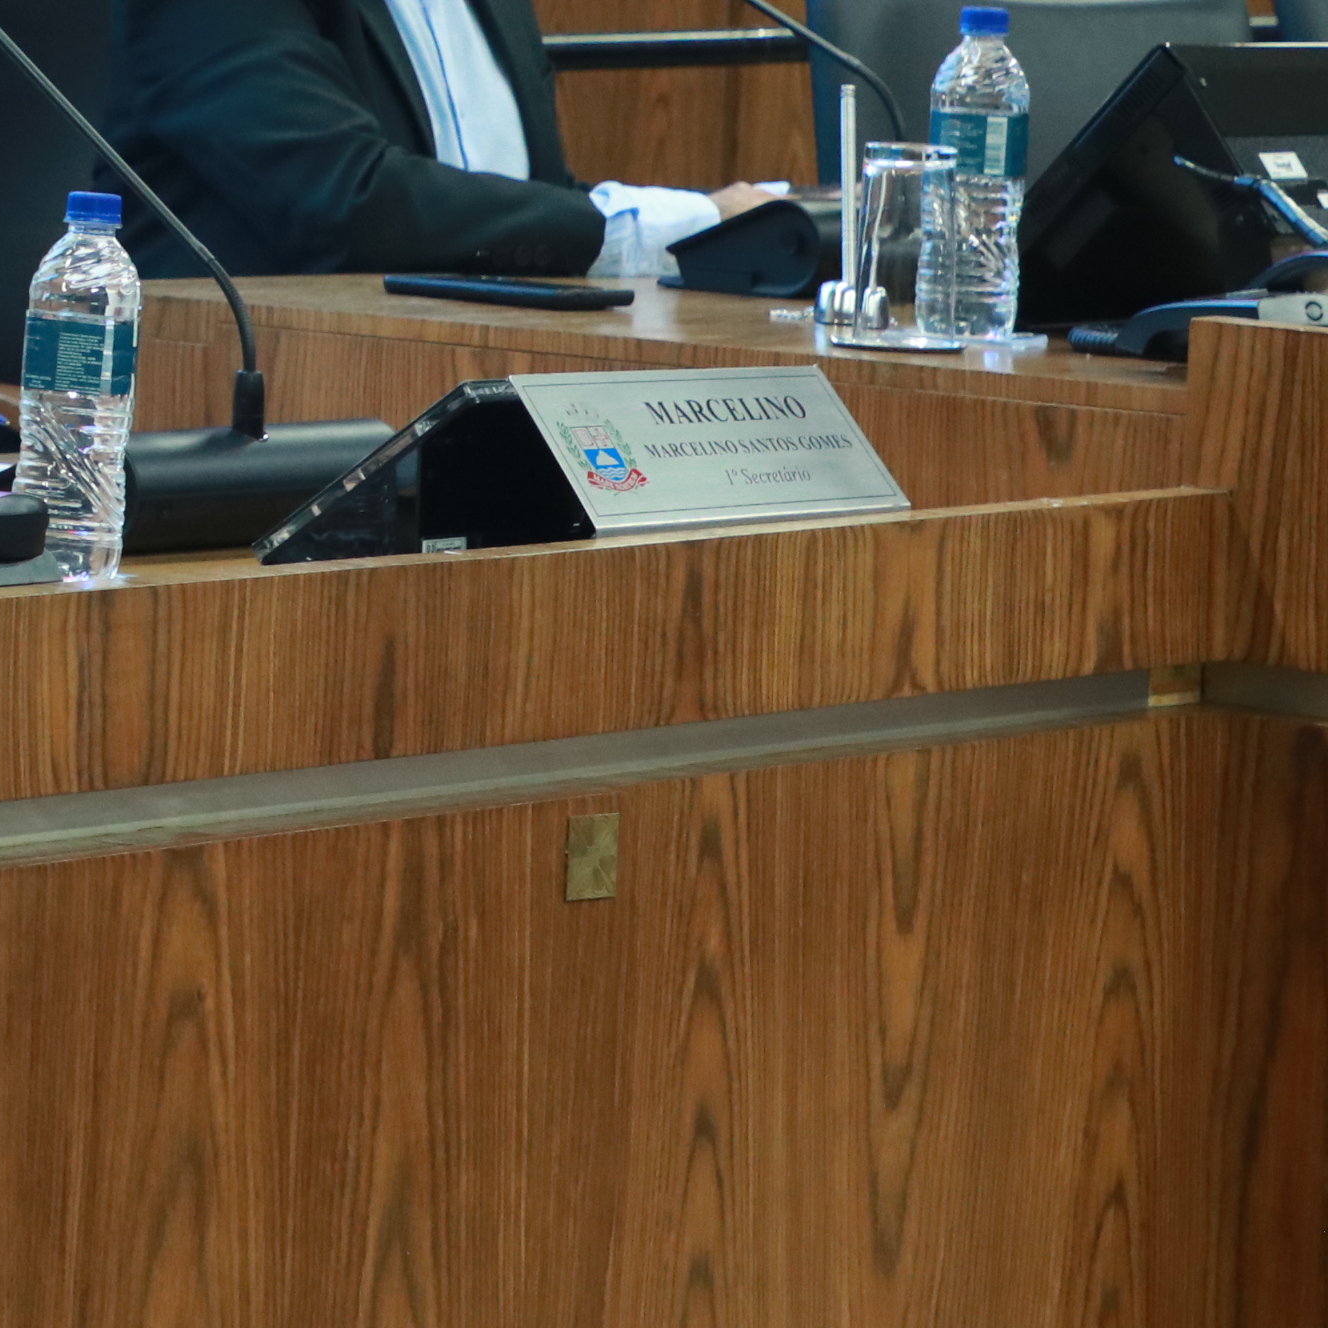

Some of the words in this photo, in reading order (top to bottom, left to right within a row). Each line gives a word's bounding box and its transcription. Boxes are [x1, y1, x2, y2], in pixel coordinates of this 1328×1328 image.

[644, 395, 807, 425] MARCELINO
[643, 439, 739, 459] MARCELINO
[738, 436, 798, 454] SANTOS
[797, 433, 853, 451] GOMES
[740, 466, 812, 486] Secretário
